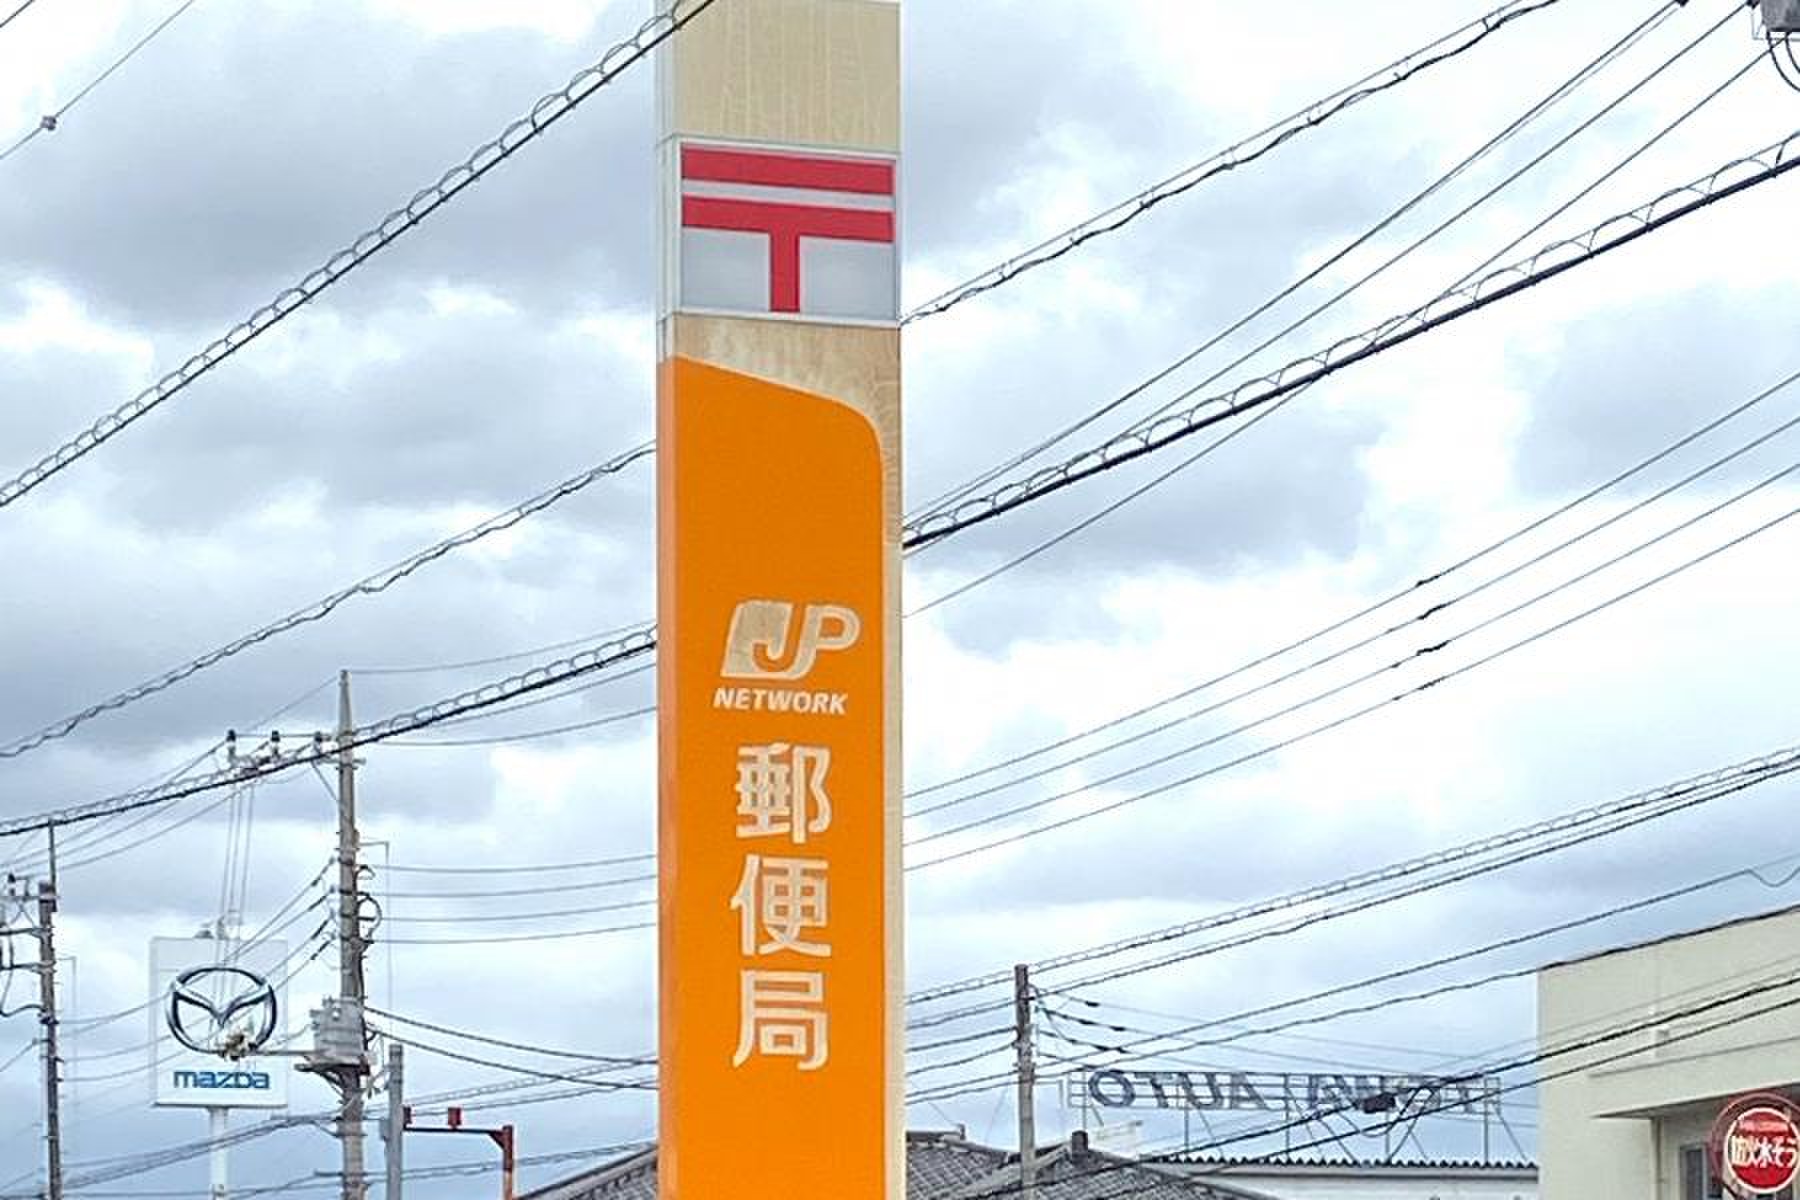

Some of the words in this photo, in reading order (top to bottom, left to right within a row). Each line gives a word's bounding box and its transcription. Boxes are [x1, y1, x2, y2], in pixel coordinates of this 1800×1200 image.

[713, 687, 849, 715] NETWORK
[729, 742, 833, 1071] 郵便局
[173, 1071, 270, 1089] mazda
